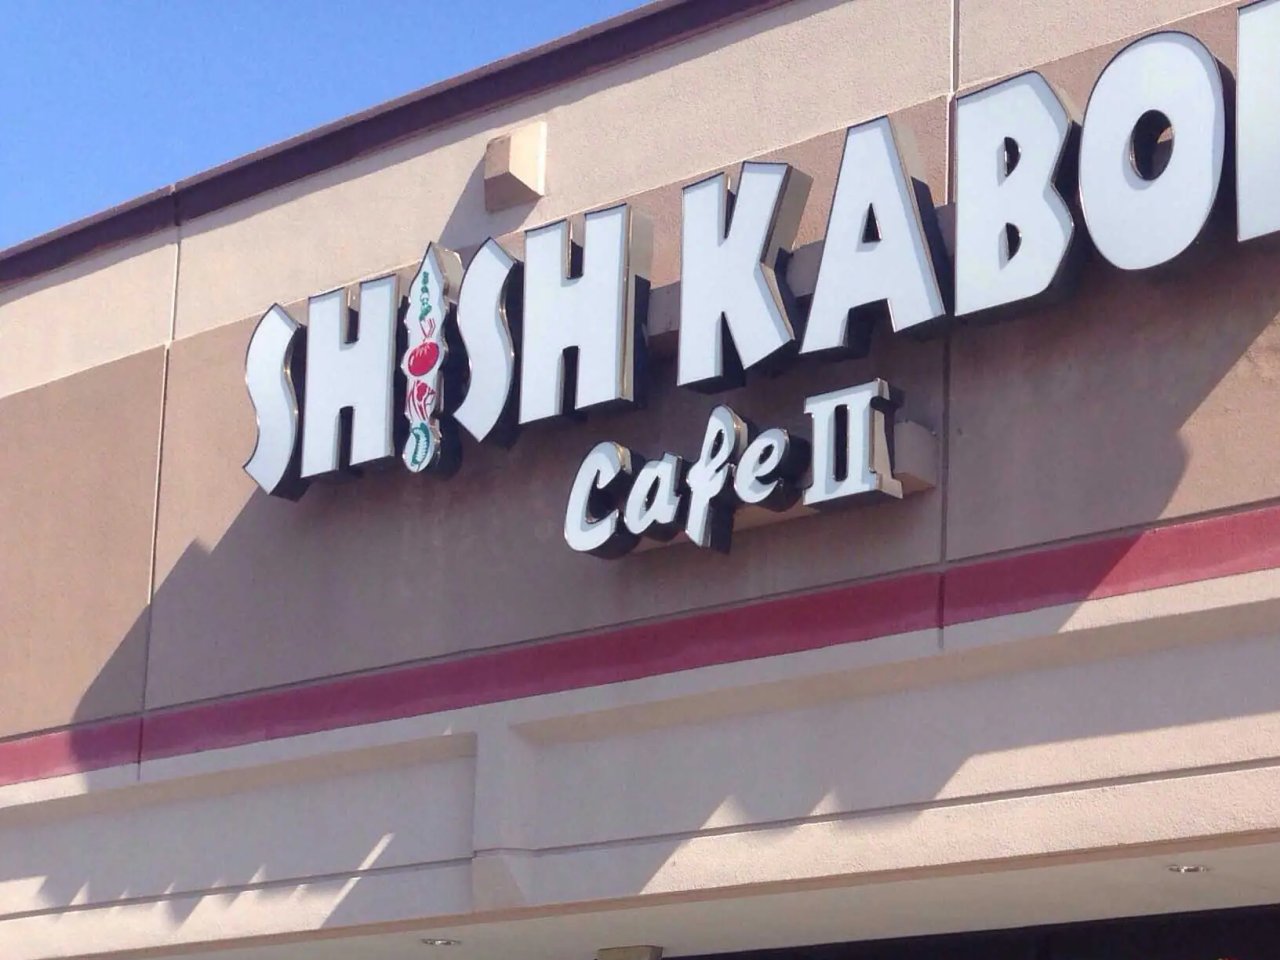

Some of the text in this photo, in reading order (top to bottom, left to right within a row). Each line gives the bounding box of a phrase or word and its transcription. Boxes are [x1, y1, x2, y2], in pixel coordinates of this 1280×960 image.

[243, 201, 644, 494] SHISH
[564, 378, 903, 551] Cafe II
